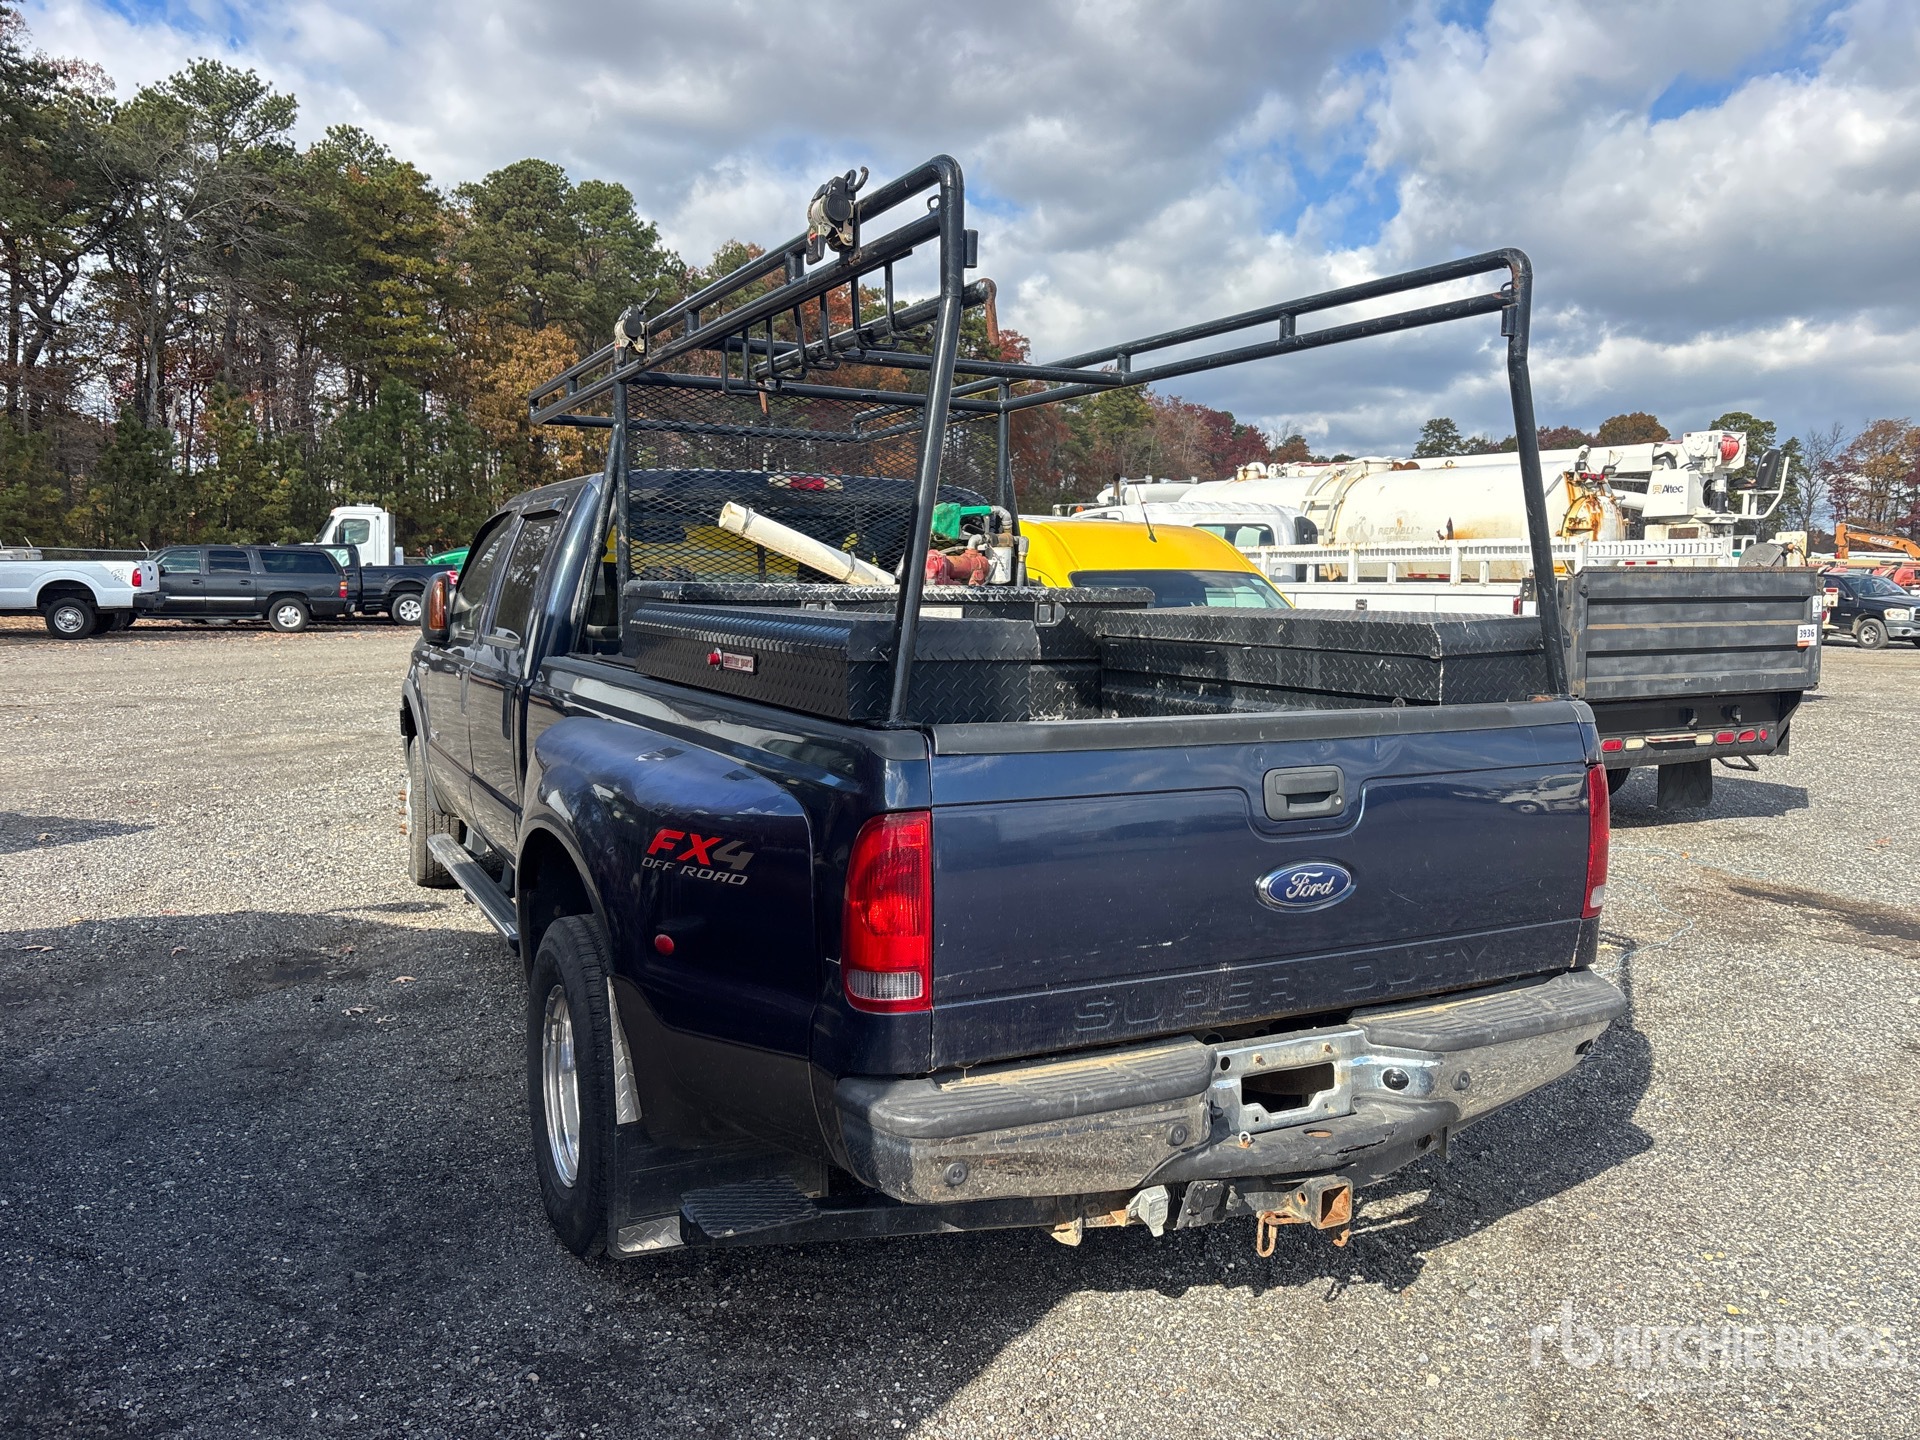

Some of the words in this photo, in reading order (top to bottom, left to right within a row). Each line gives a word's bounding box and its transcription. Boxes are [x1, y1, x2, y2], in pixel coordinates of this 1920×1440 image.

[1662, 483, 1683, 493] Altec
[1869, 536, 1895, 546] CASE
[1799, 628, 1815, 638] 3936
[647, 828, 755, 871] FX4
[641, 857, 676, 871] OFF
[680, 865, 748, 885] ROAD
[1286, 872, 1335, 898] Ford
[1074, 976, 1296, 1032] SUPER
[1342, 945, 1488, 993] DUTY
